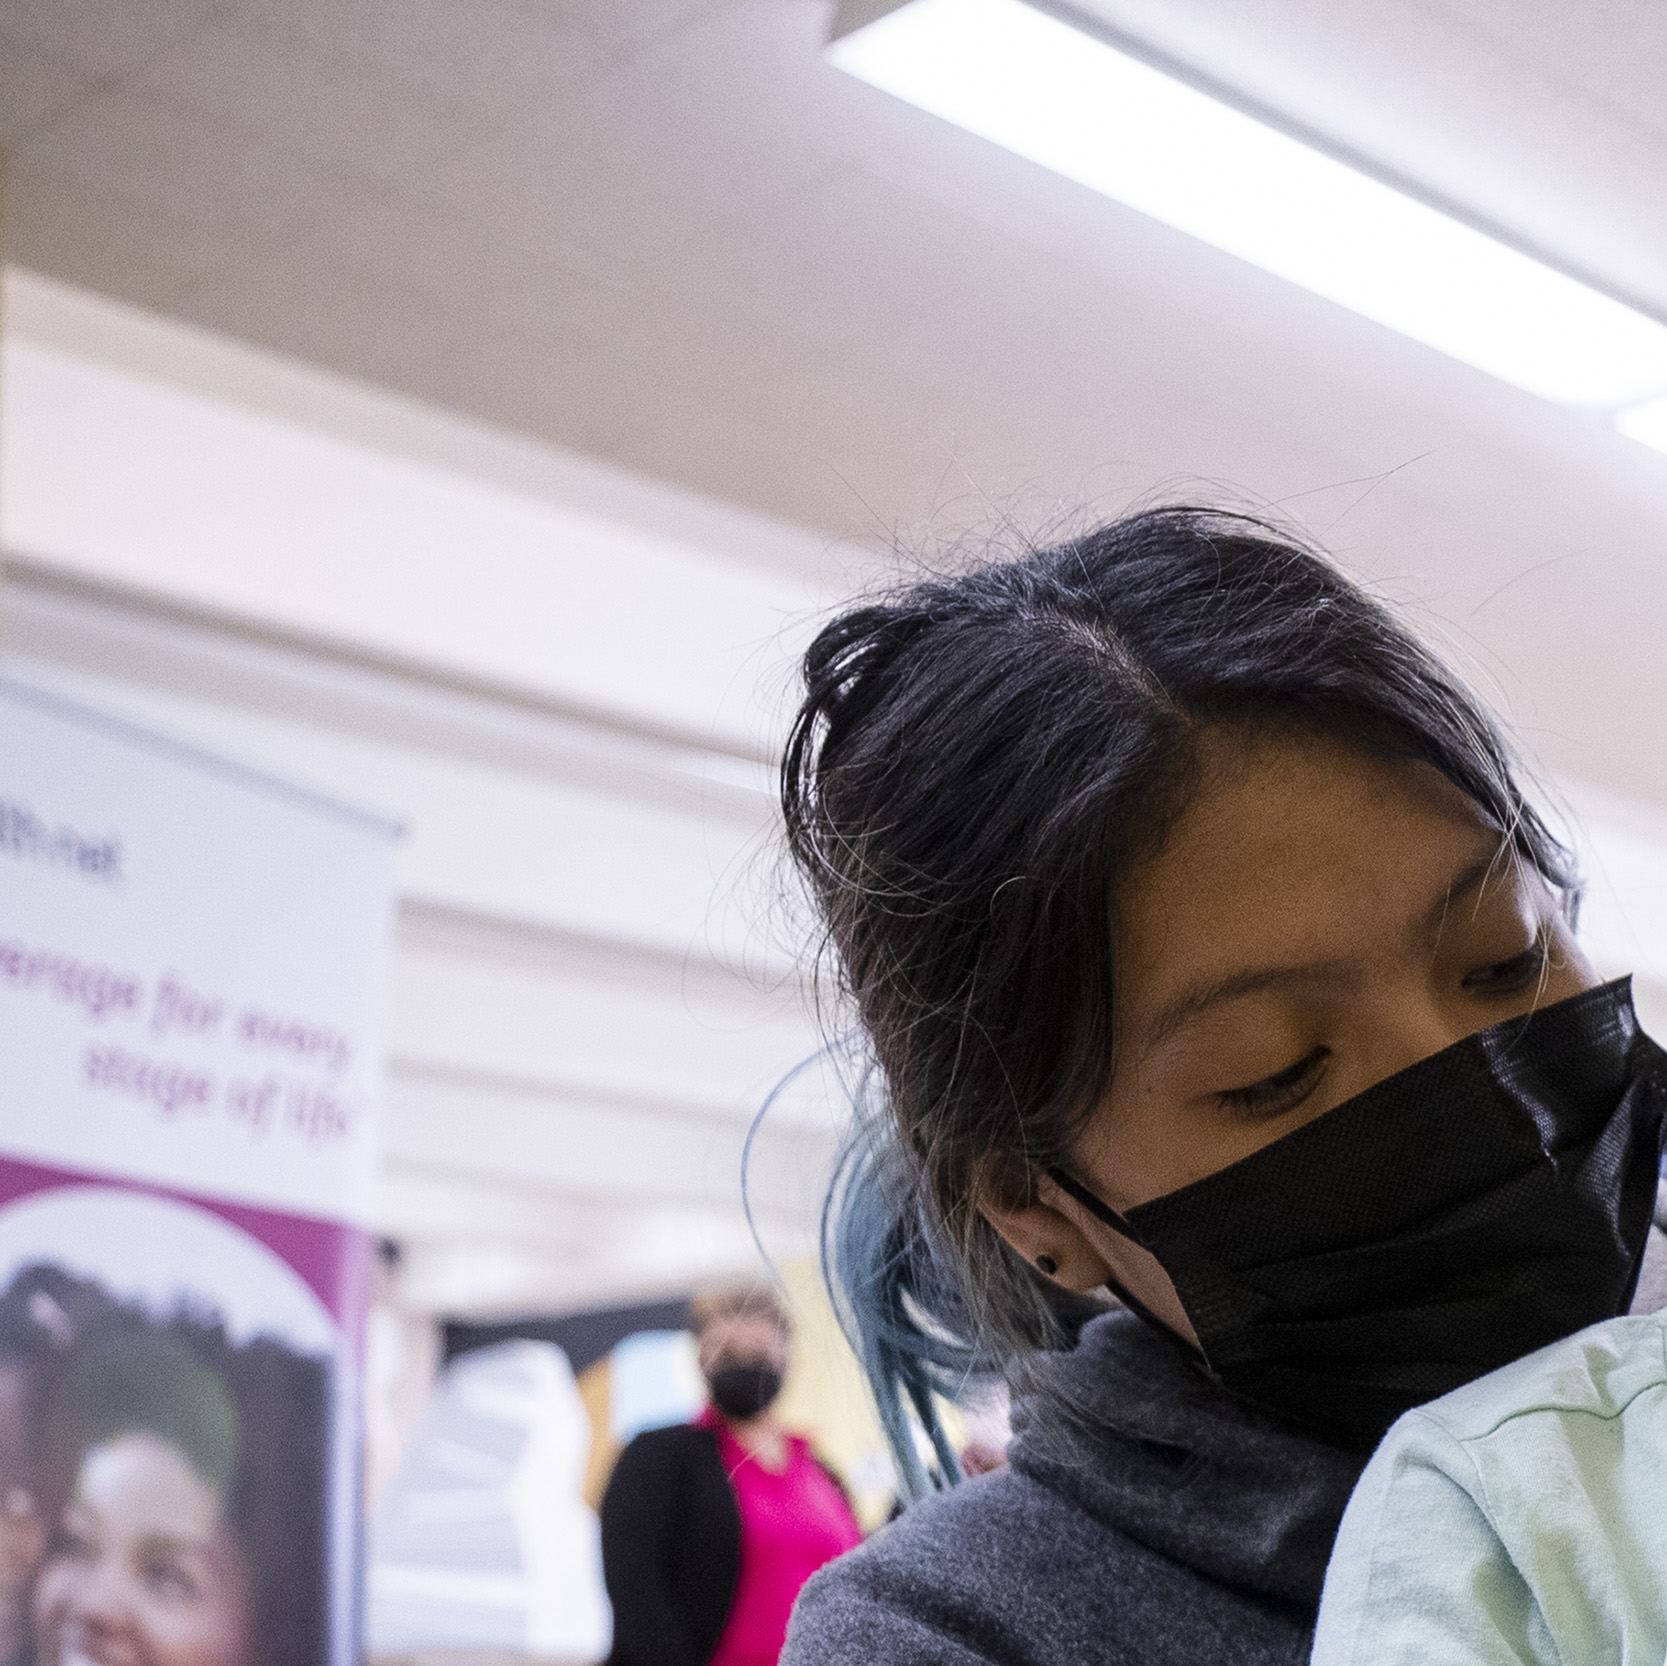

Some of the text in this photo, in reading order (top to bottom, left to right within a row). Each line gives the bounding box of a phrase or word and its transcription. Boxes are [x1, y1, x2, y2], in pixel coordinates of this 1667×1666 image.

[148, 974, 224, 1035] for
[239, 1006, 351, 1073] every
[82, 1040, 353, 1143] stage of life
